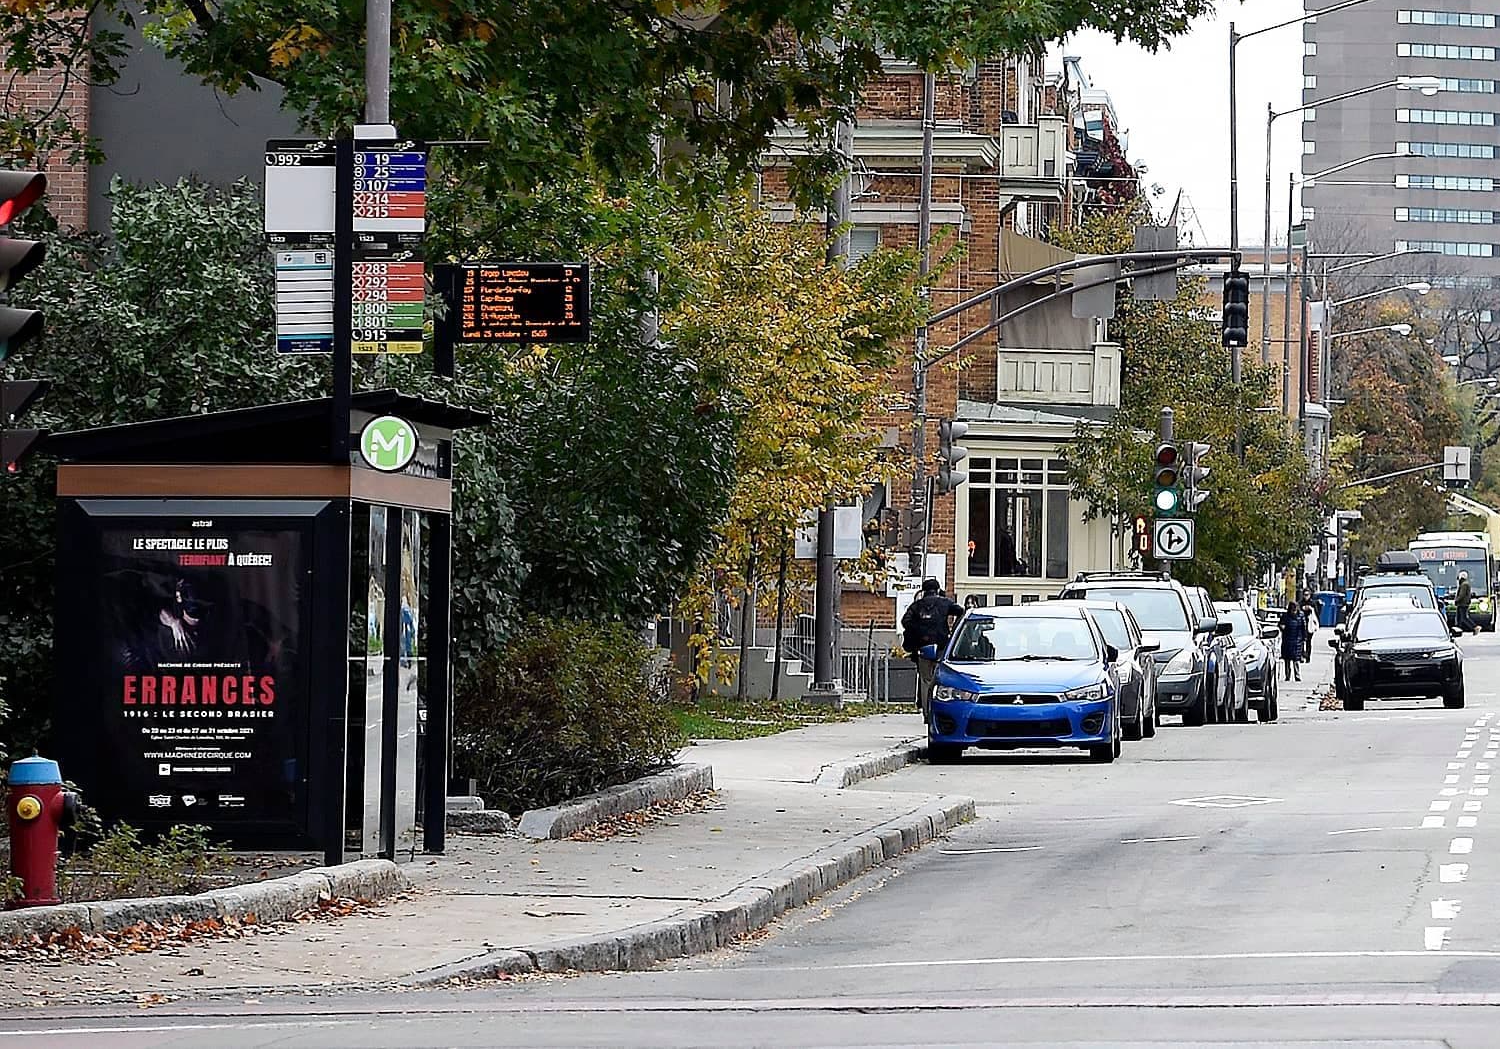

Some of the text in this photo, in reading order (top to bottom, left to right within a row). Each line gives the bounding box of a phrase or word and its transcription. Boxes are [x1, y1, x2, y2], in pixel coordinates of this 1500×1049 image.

[278, 154, 301, 166] 992
[375, 153, 390, 165] 19
[374, 166, 389, 178] 25
[367, 180, 389, 191] 107
[366, 193, 389, 204] 214
[366, 206, 389, 217] 215
[365, 263, 388, 275] 283
[365, 277, 388, 288] 292
[365, 290, 388, 301] 294
[364, 303, 388, 314] 800
[364, 316, 386, 327] 801
[364, 329, 387, 341] 915
[133, 538, 229, 550] LE SPECTACLE LE PLUS
[178, 554, 227, 566] TERRIFIANT
[123, 675, 275, 705] ERRANCES
[123, 710, 149, 718] 1916
[162, 710, 175, 718] LE
[179, 710, 223, 718] SECOND
[227, 710, 275, 718] BRASIER
